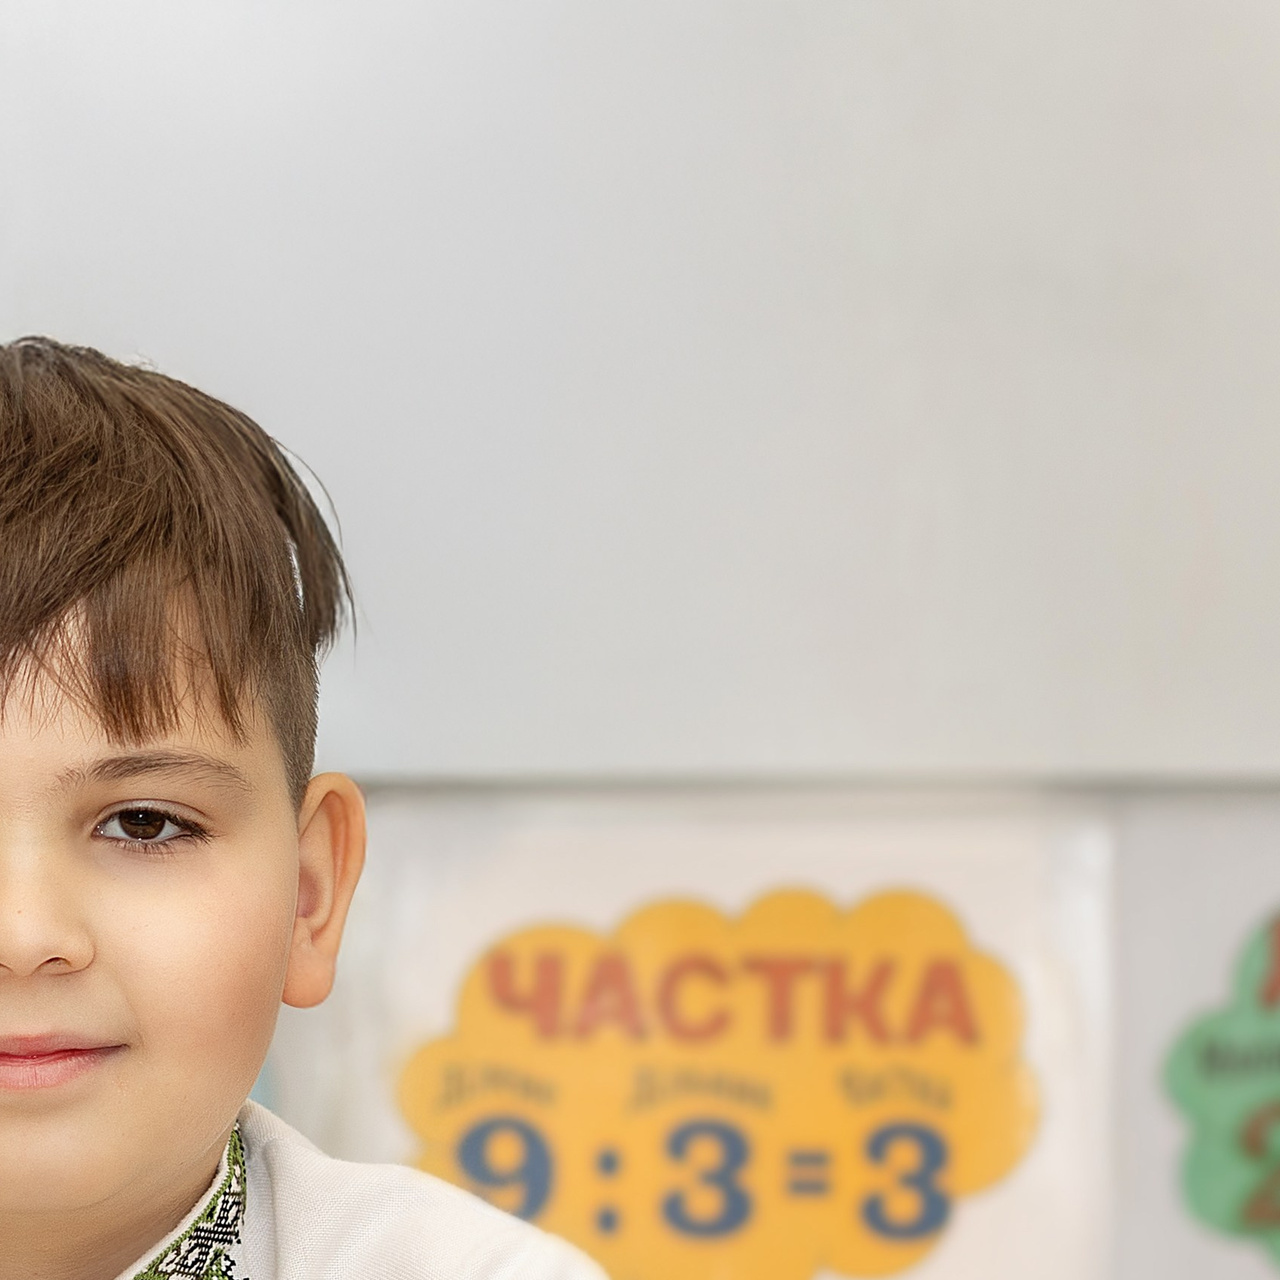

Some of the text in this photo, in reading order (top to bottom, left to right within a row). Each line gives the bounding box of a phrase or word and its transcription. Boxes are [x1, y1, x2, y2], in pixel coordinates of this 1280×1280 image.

[488, 952, 982, 1046] ЧАСТКА
[660, 1118, 756, 1238] 3
[858, 1122, 952, 1242] 3
